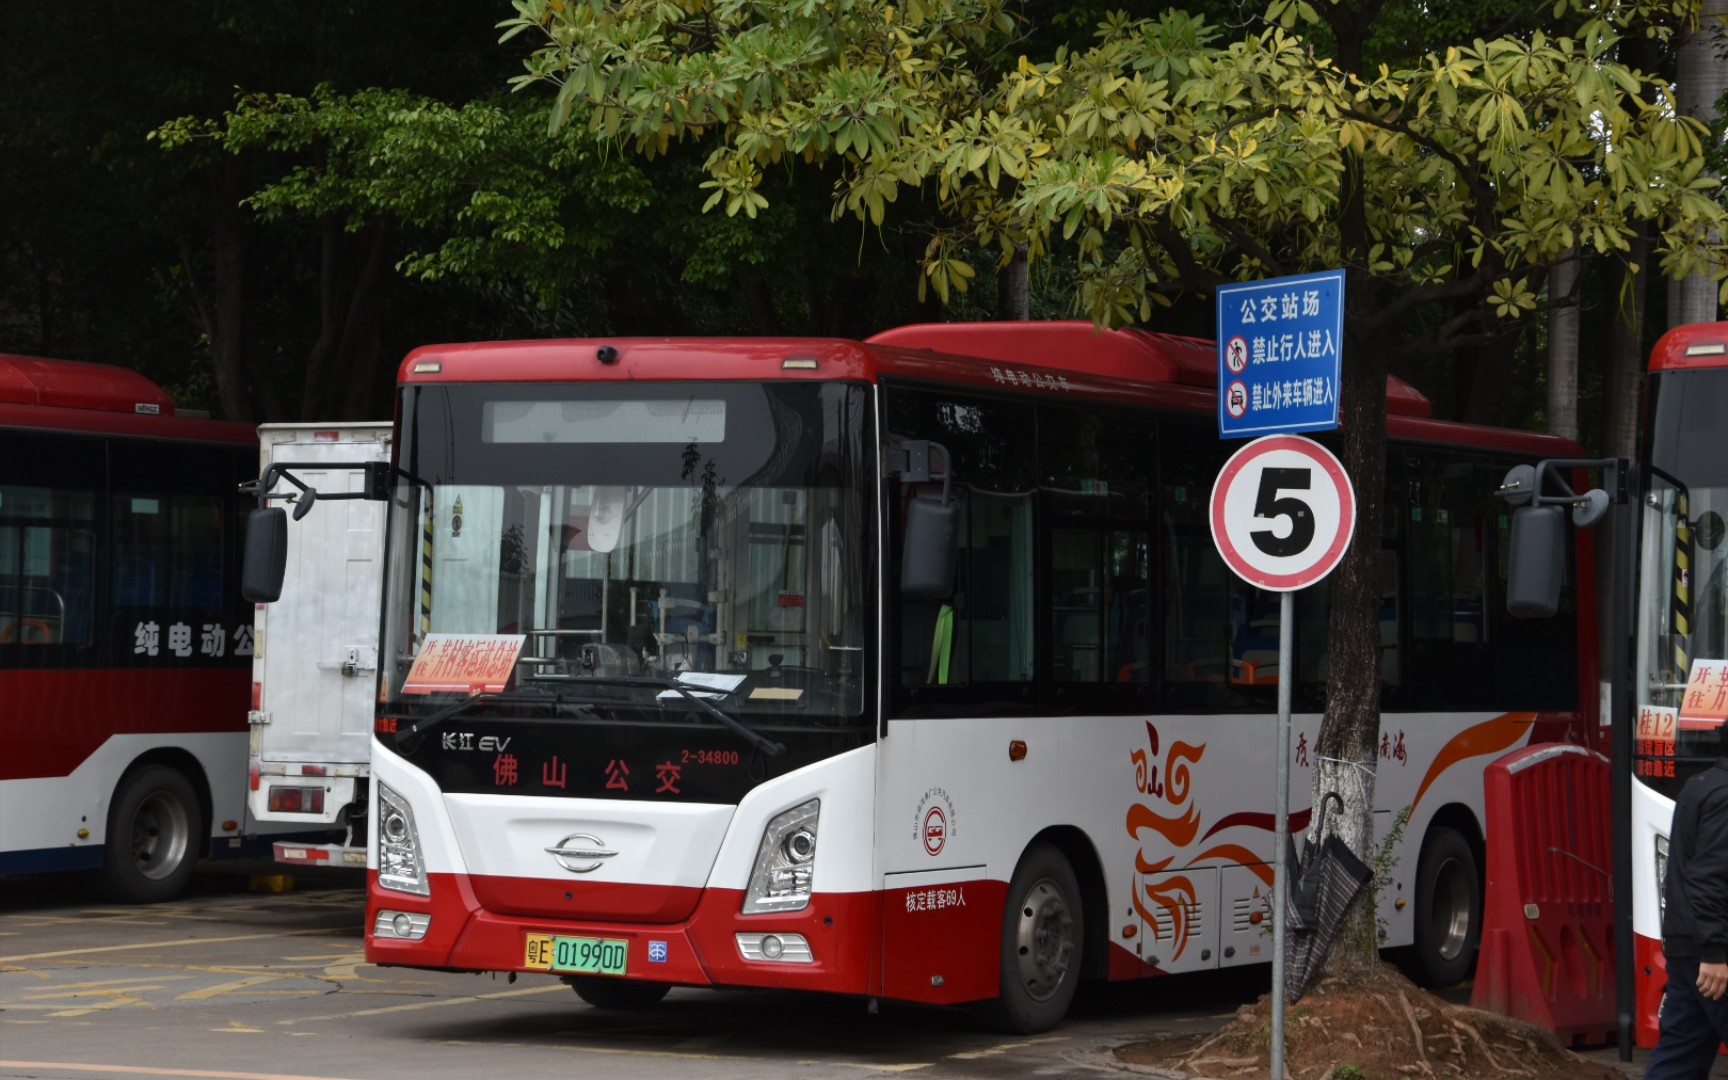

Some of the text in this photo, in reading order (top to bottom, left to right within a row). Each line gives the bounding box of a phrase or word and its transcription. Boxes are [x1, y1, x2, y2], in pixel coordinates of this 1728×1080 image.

[1240, 289, 1320, 325] 公交站场
[1252, 328, 1335, 365] 禁止行人进入
[1252, 376, 1333, 411] 禁止外来车辆进入
[1249, 467, 1316, 558] 5
[1638, 708, 1674, 738] 桂12
[441, 731, 511, 752] 长江 EV
[681, 749, 739, 765] 2-34800
[492, 753, 682, 795] 佛山公交
[905, 886, 967, 913] 核定载客69人
